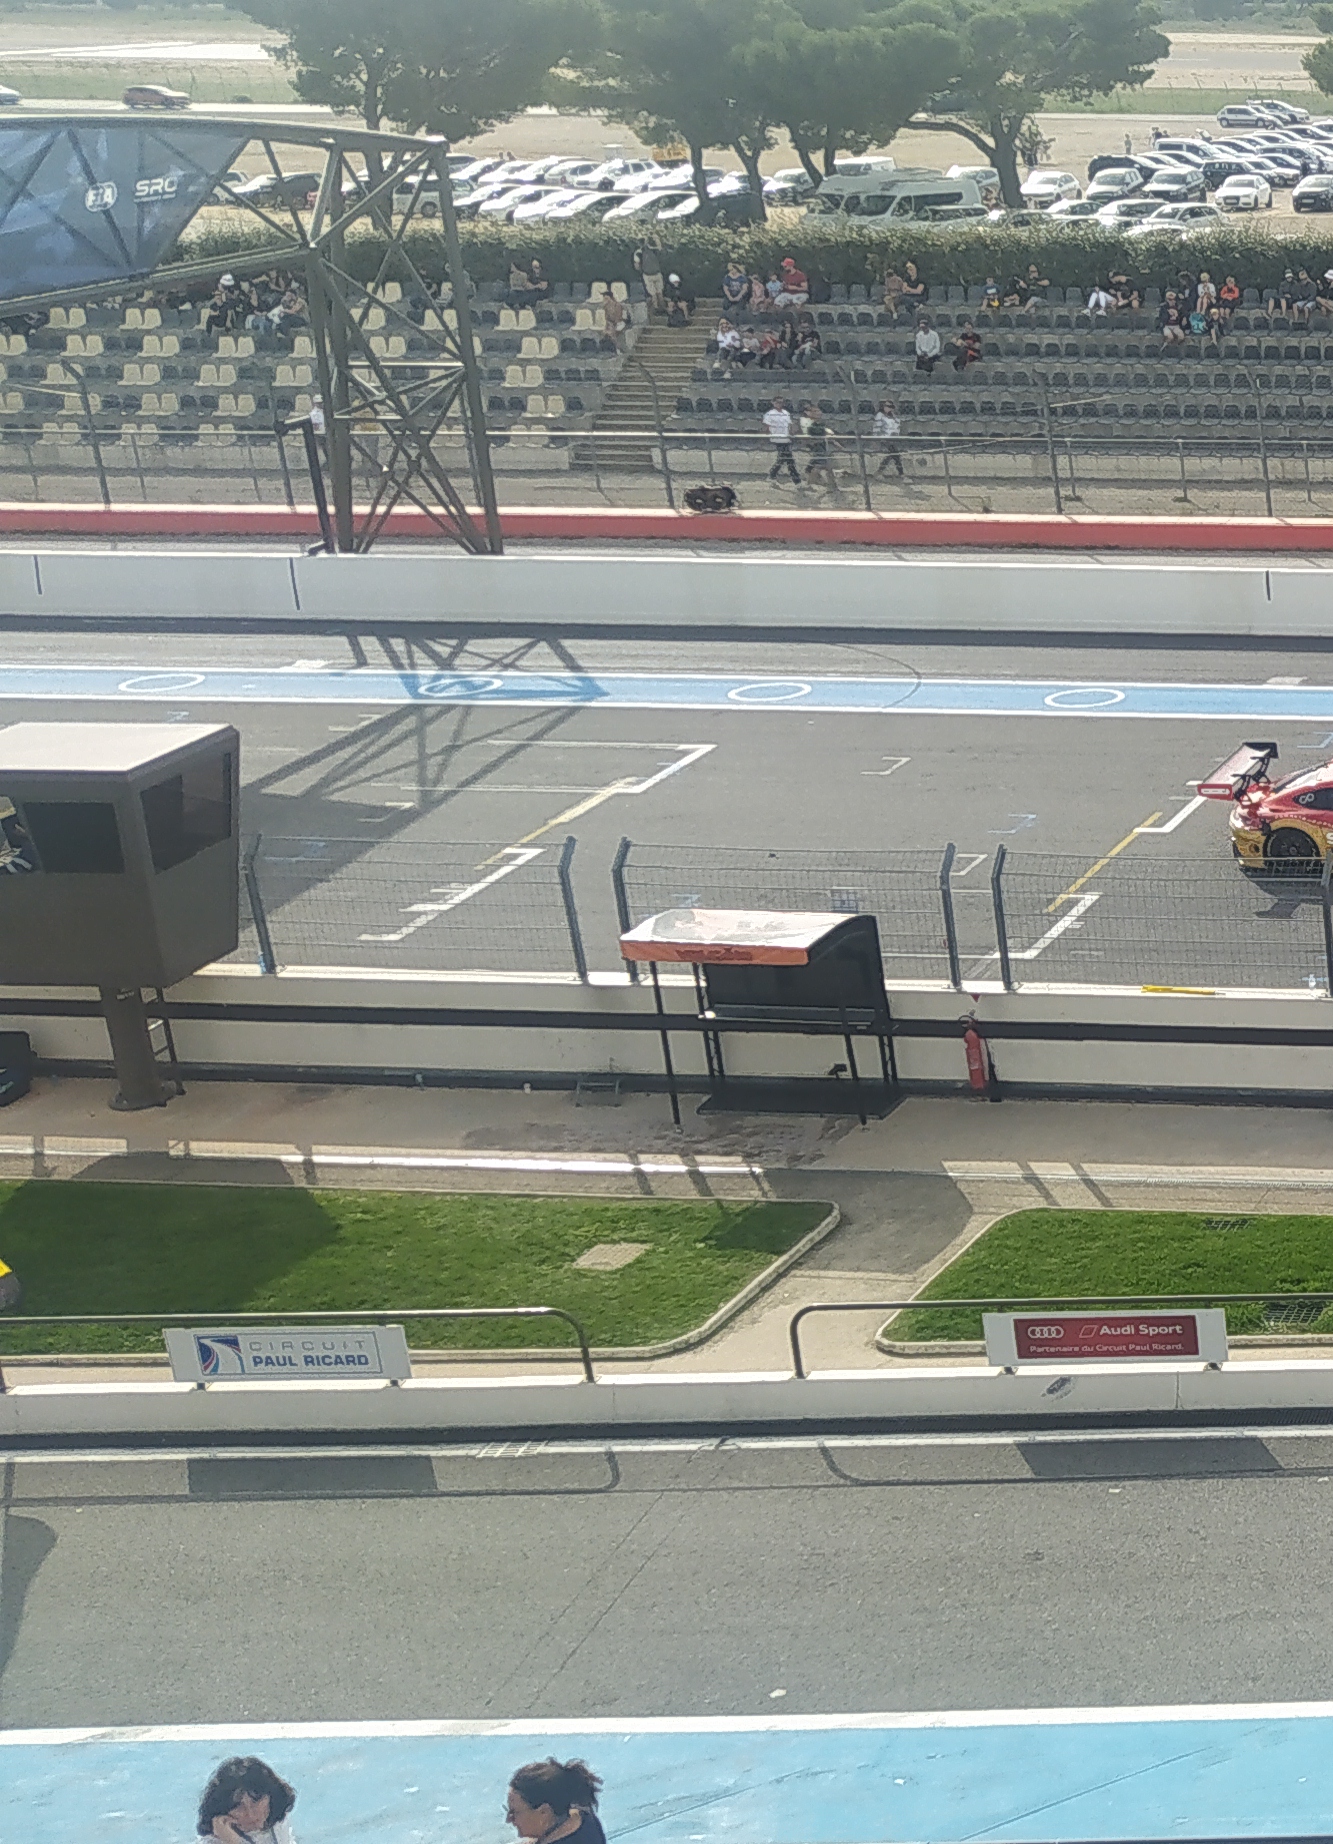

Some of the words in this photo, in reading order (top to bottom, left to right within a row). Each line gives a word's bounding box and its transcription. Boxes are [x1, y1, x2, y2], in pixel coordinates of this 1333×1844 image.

[1099, 1324, 1135, 1336] Audi
[1138, 1323, 1183, 1337] Sport
[248, 1339, 367, 1353] CIRCUIT
[252, 1355, 298, 1369] PAUL
[303, 1353, 369, 1367] RICARD
